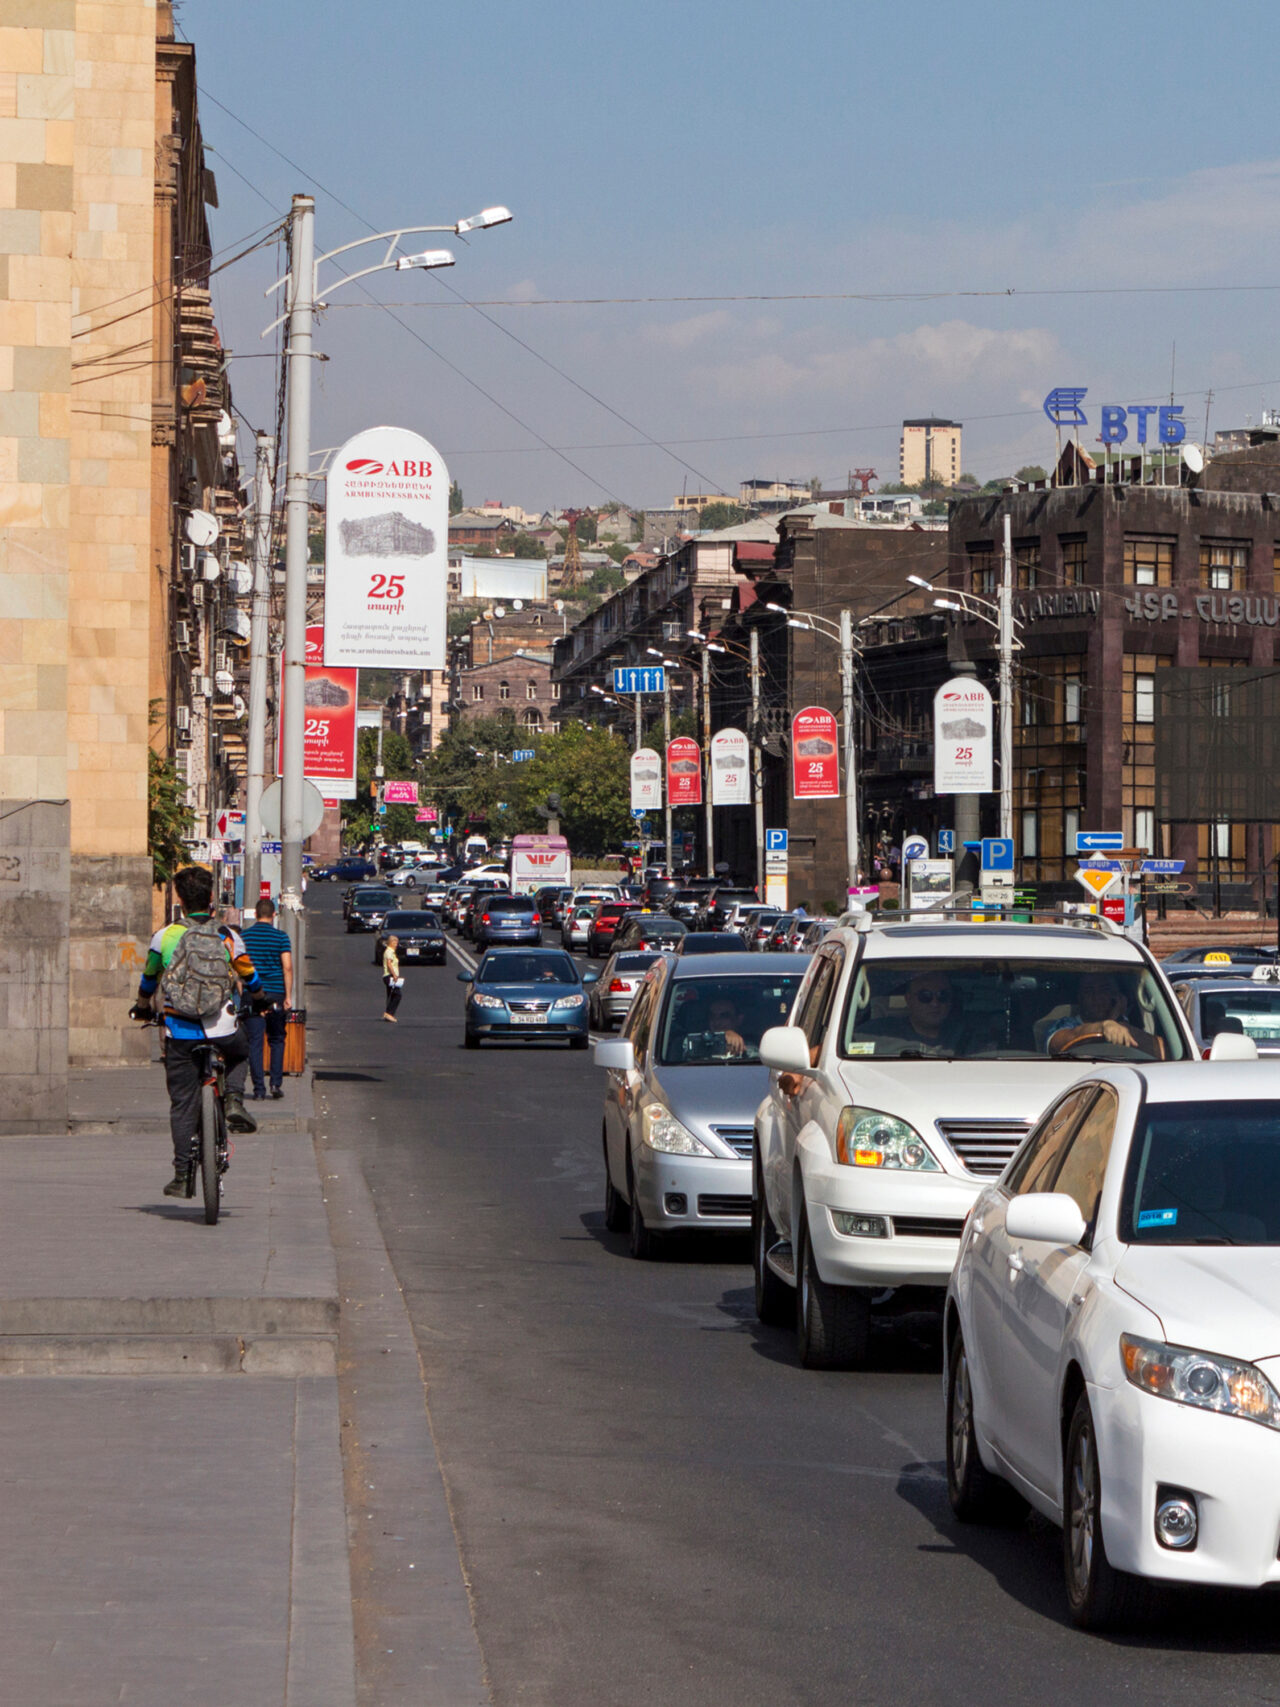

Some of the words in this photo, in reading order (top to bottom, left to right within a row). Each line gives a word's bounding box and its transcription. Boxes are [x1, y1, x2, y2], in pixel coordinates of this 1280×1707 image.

[1101, 405, 1186, 443] ВТБ
[385, 459, 433, 477] ABB
[367, 573, 405, 599] 25
[962, 692, 985, 701] ABB
[305, 719, 330, 736] 25
[813, 716, 832, 724] ABB
[955, 747, 973, 760] 25
[808, 762, 824, 773] 25
[679, 778, 691, 786] 25
[725, 774, 737, 783] 25
[771, 831, 783, 849] P
[990, 842, 1007, 867] P
